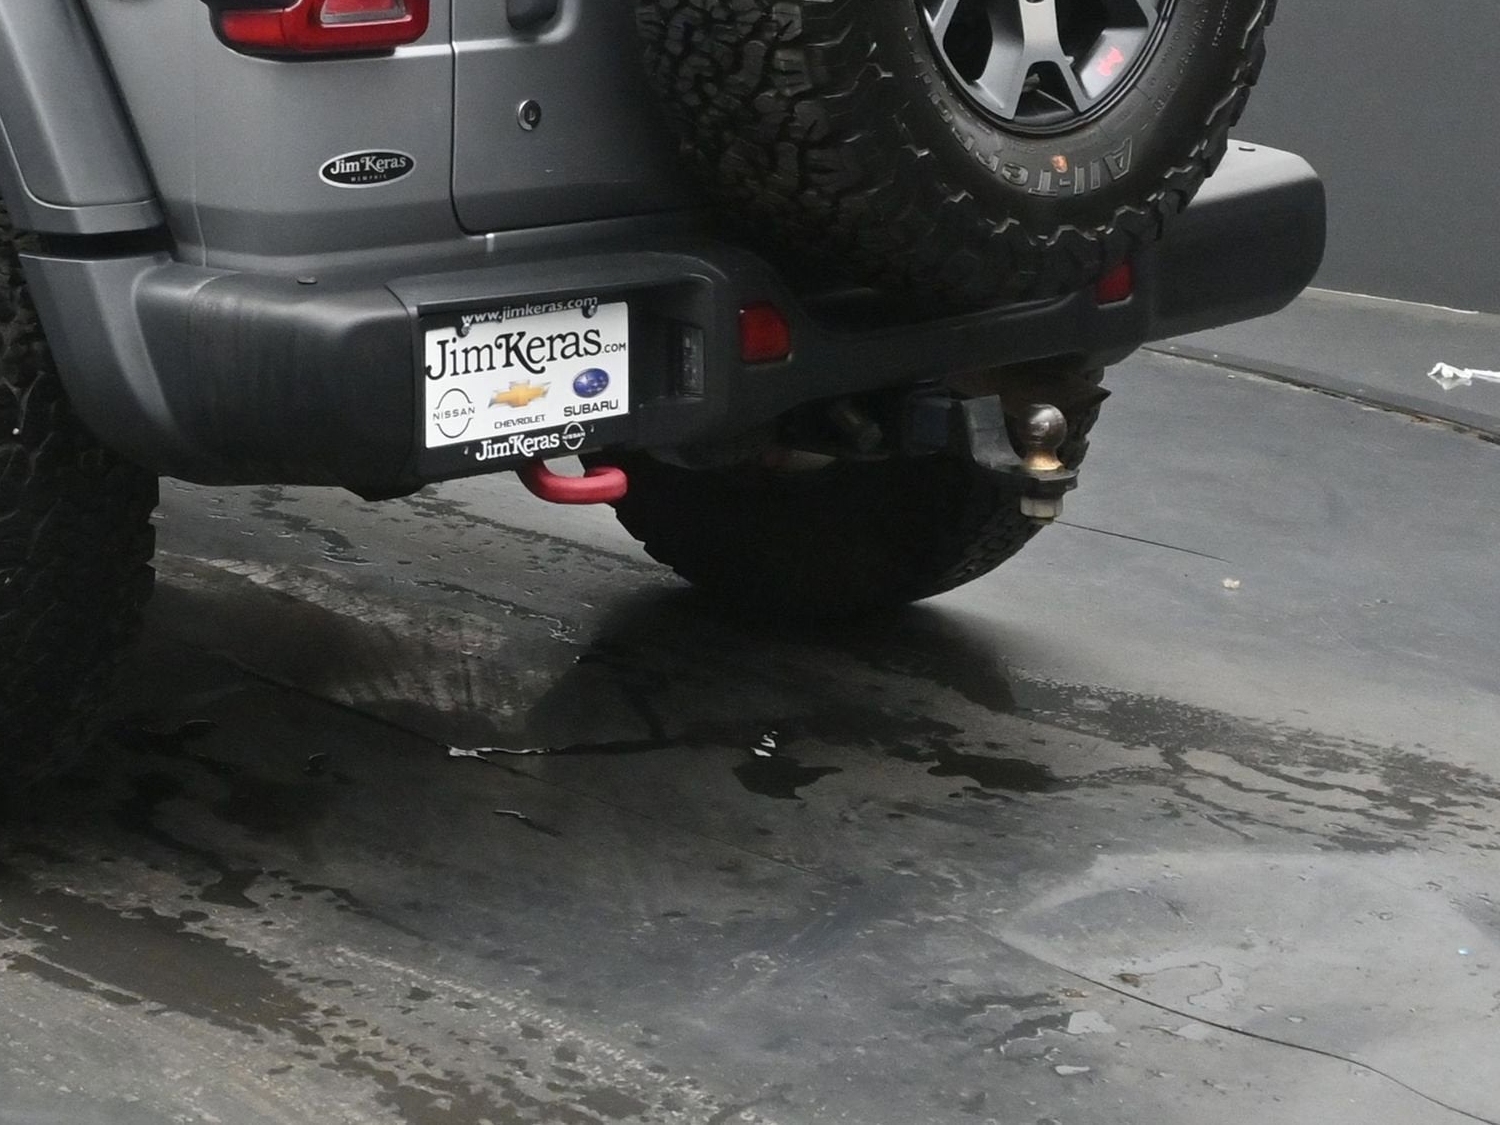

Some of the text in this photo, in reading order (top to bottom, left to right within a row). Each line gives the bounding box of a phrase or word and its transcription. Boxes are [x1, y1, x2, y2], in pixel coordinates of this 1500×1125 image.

[461, 296, 598, 324] www.jimkeras.com
[433, 406, 476, 421] NISSAN
[564, 399, 619, 417] SUBARU
[494, 414, 547, 429] CHEVROLET
